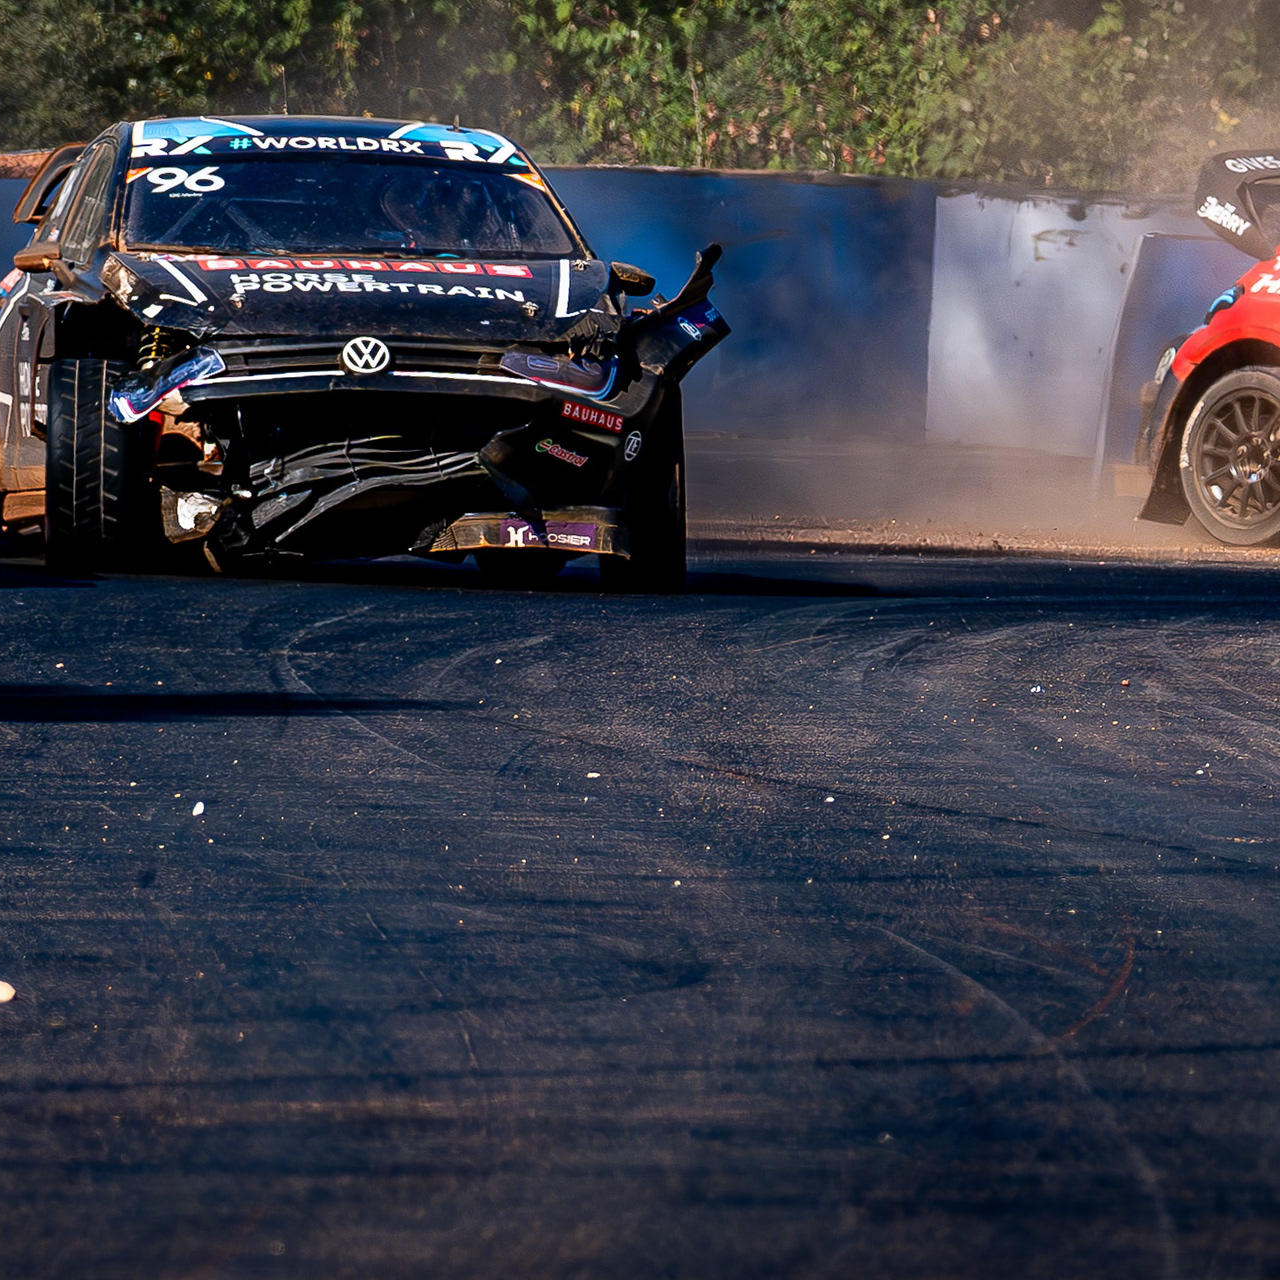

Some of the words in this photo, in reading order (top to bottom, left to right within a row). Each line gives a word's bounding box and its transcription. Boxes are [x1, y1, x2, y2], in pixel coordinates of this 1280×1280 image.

[229, 136, 425, 154] #WORLDRX
[146, 166, 225, 194] 96
[213, 259, 532, 278] BAUHAUS
[234, 281, 525, 302] POWERTRAIN
[563, 403, 624, 431] BAUHAUS
[547, 444, 589, 467] Castrol
